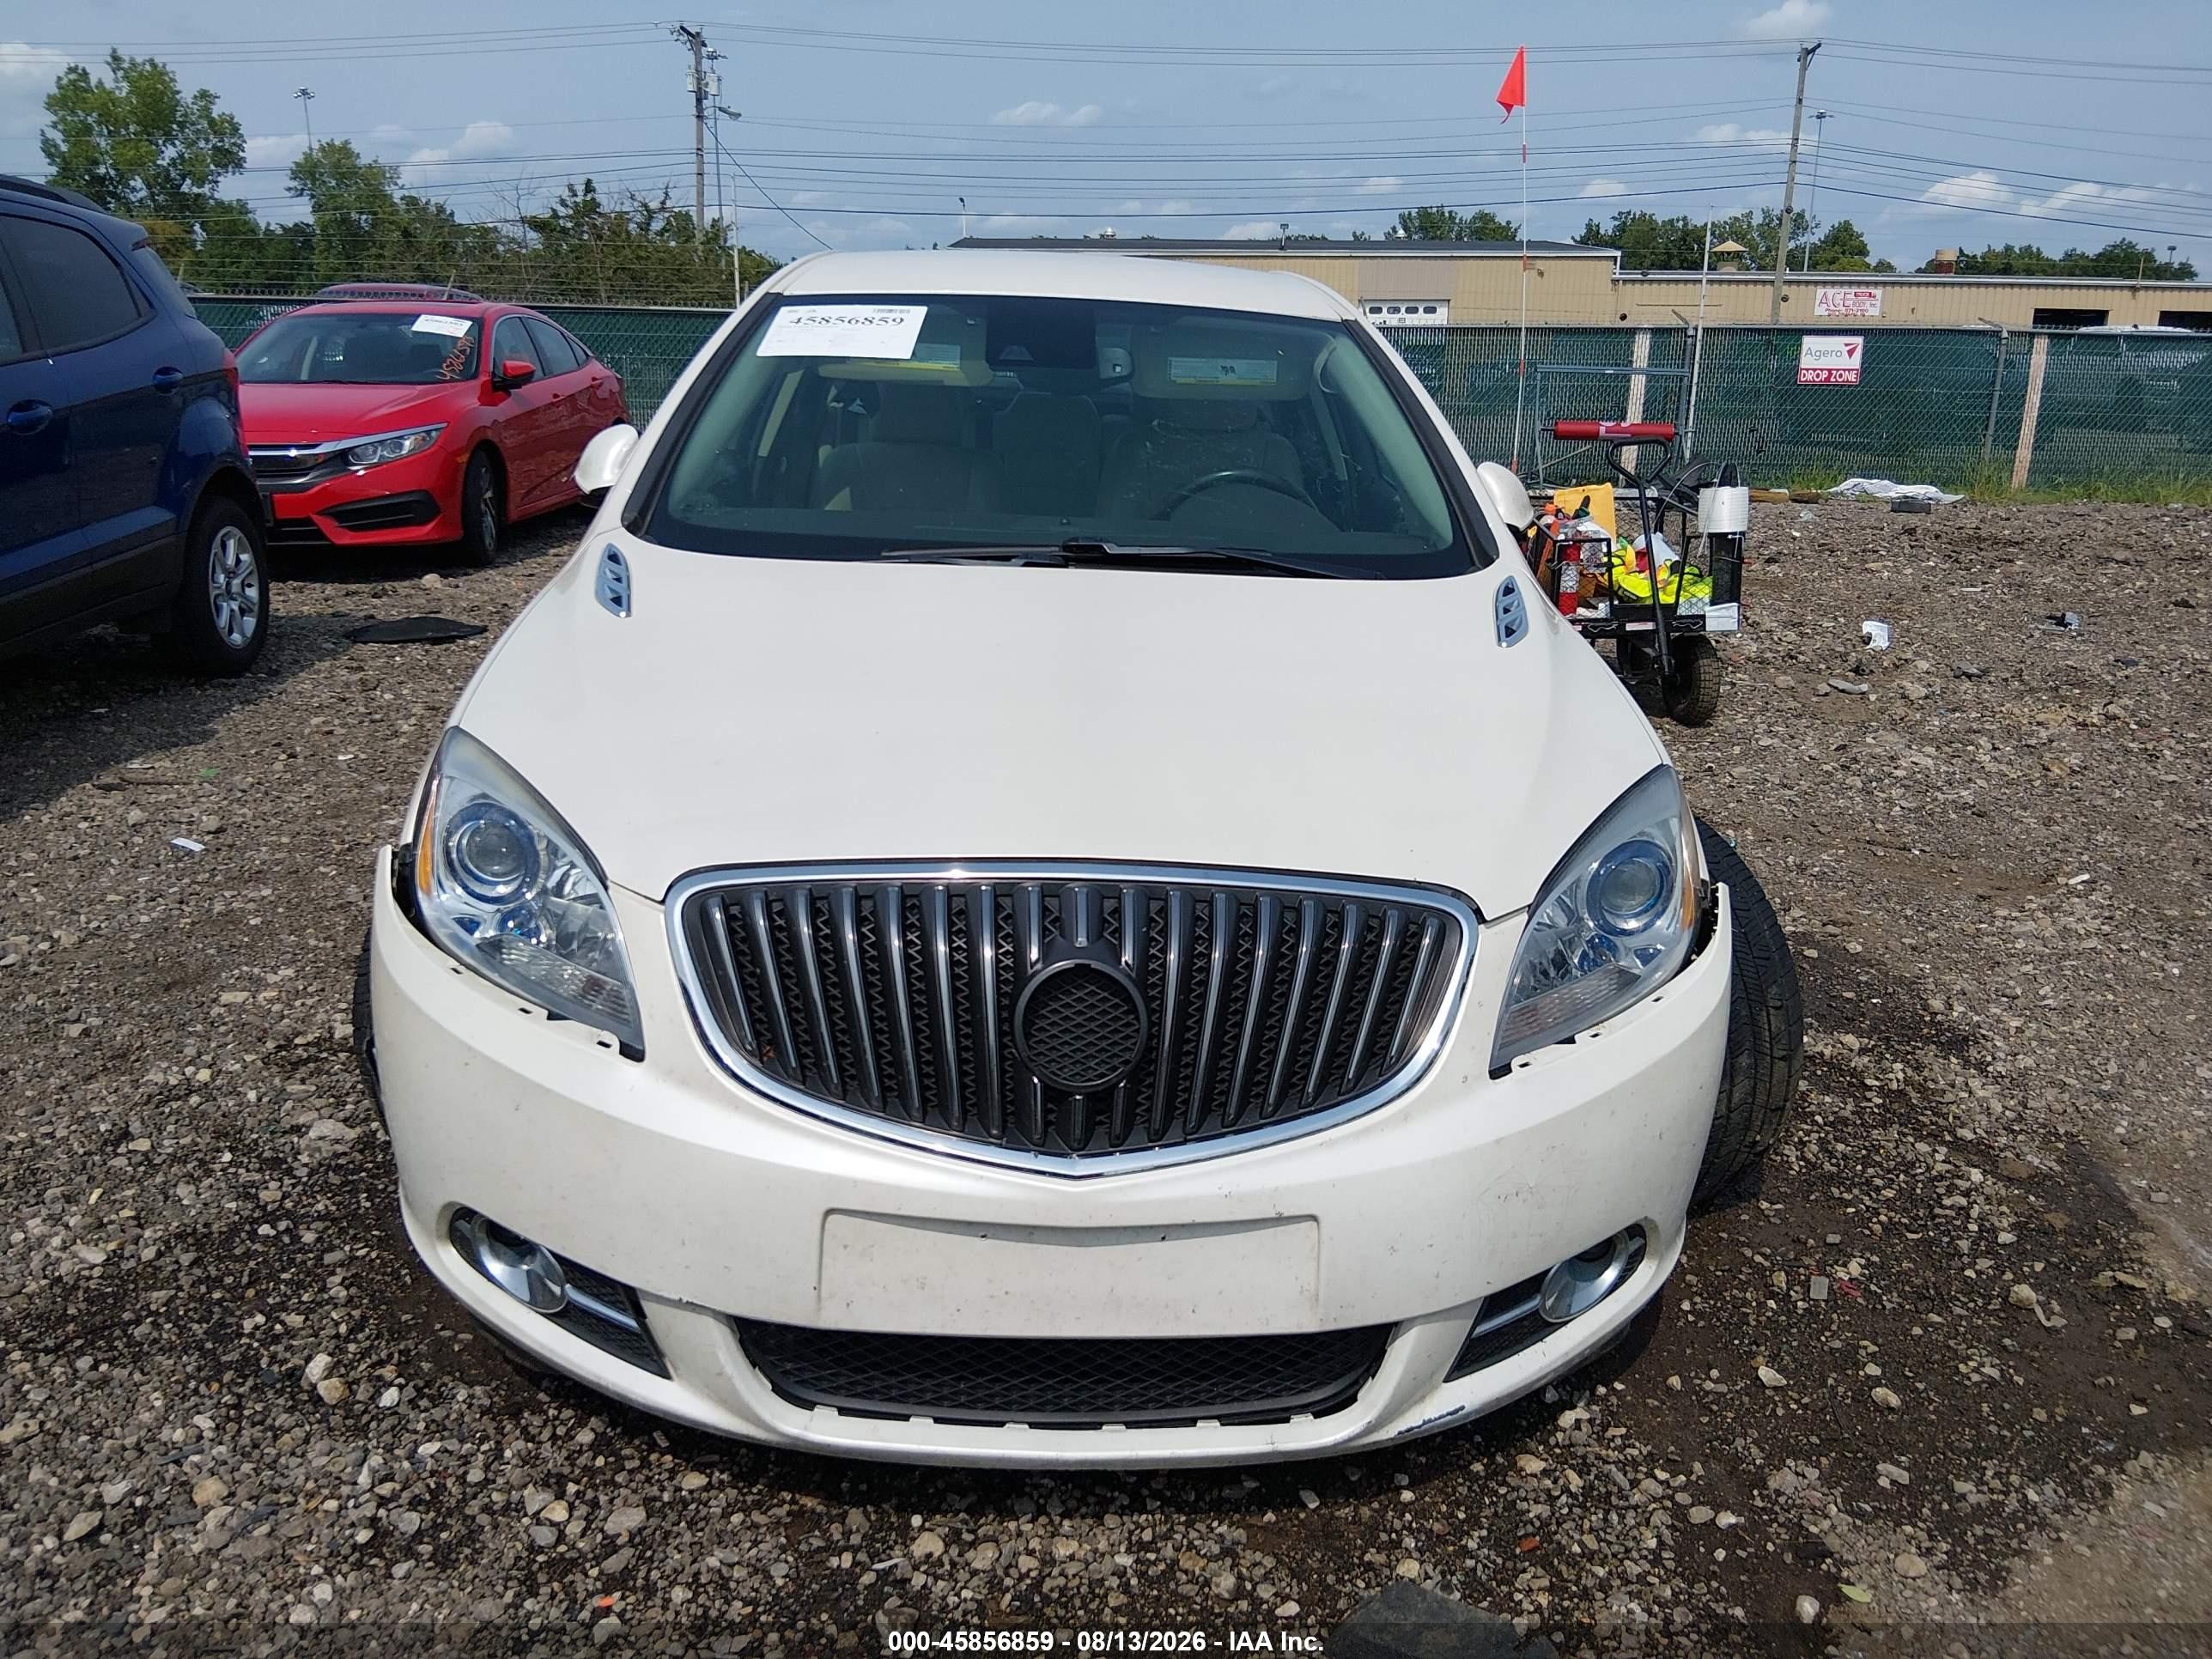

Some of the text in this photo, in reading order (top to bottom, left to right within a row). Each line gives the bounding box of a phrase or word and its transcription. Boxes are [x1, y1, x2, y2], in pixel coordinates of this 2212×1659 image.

[1819, 290, 1852, 307] ACE
[789, 316, 905, 326] 45856859
[1804, 347, 1843, 361] Agero
[1801, 370, 1857, 382] DROP ZONE
